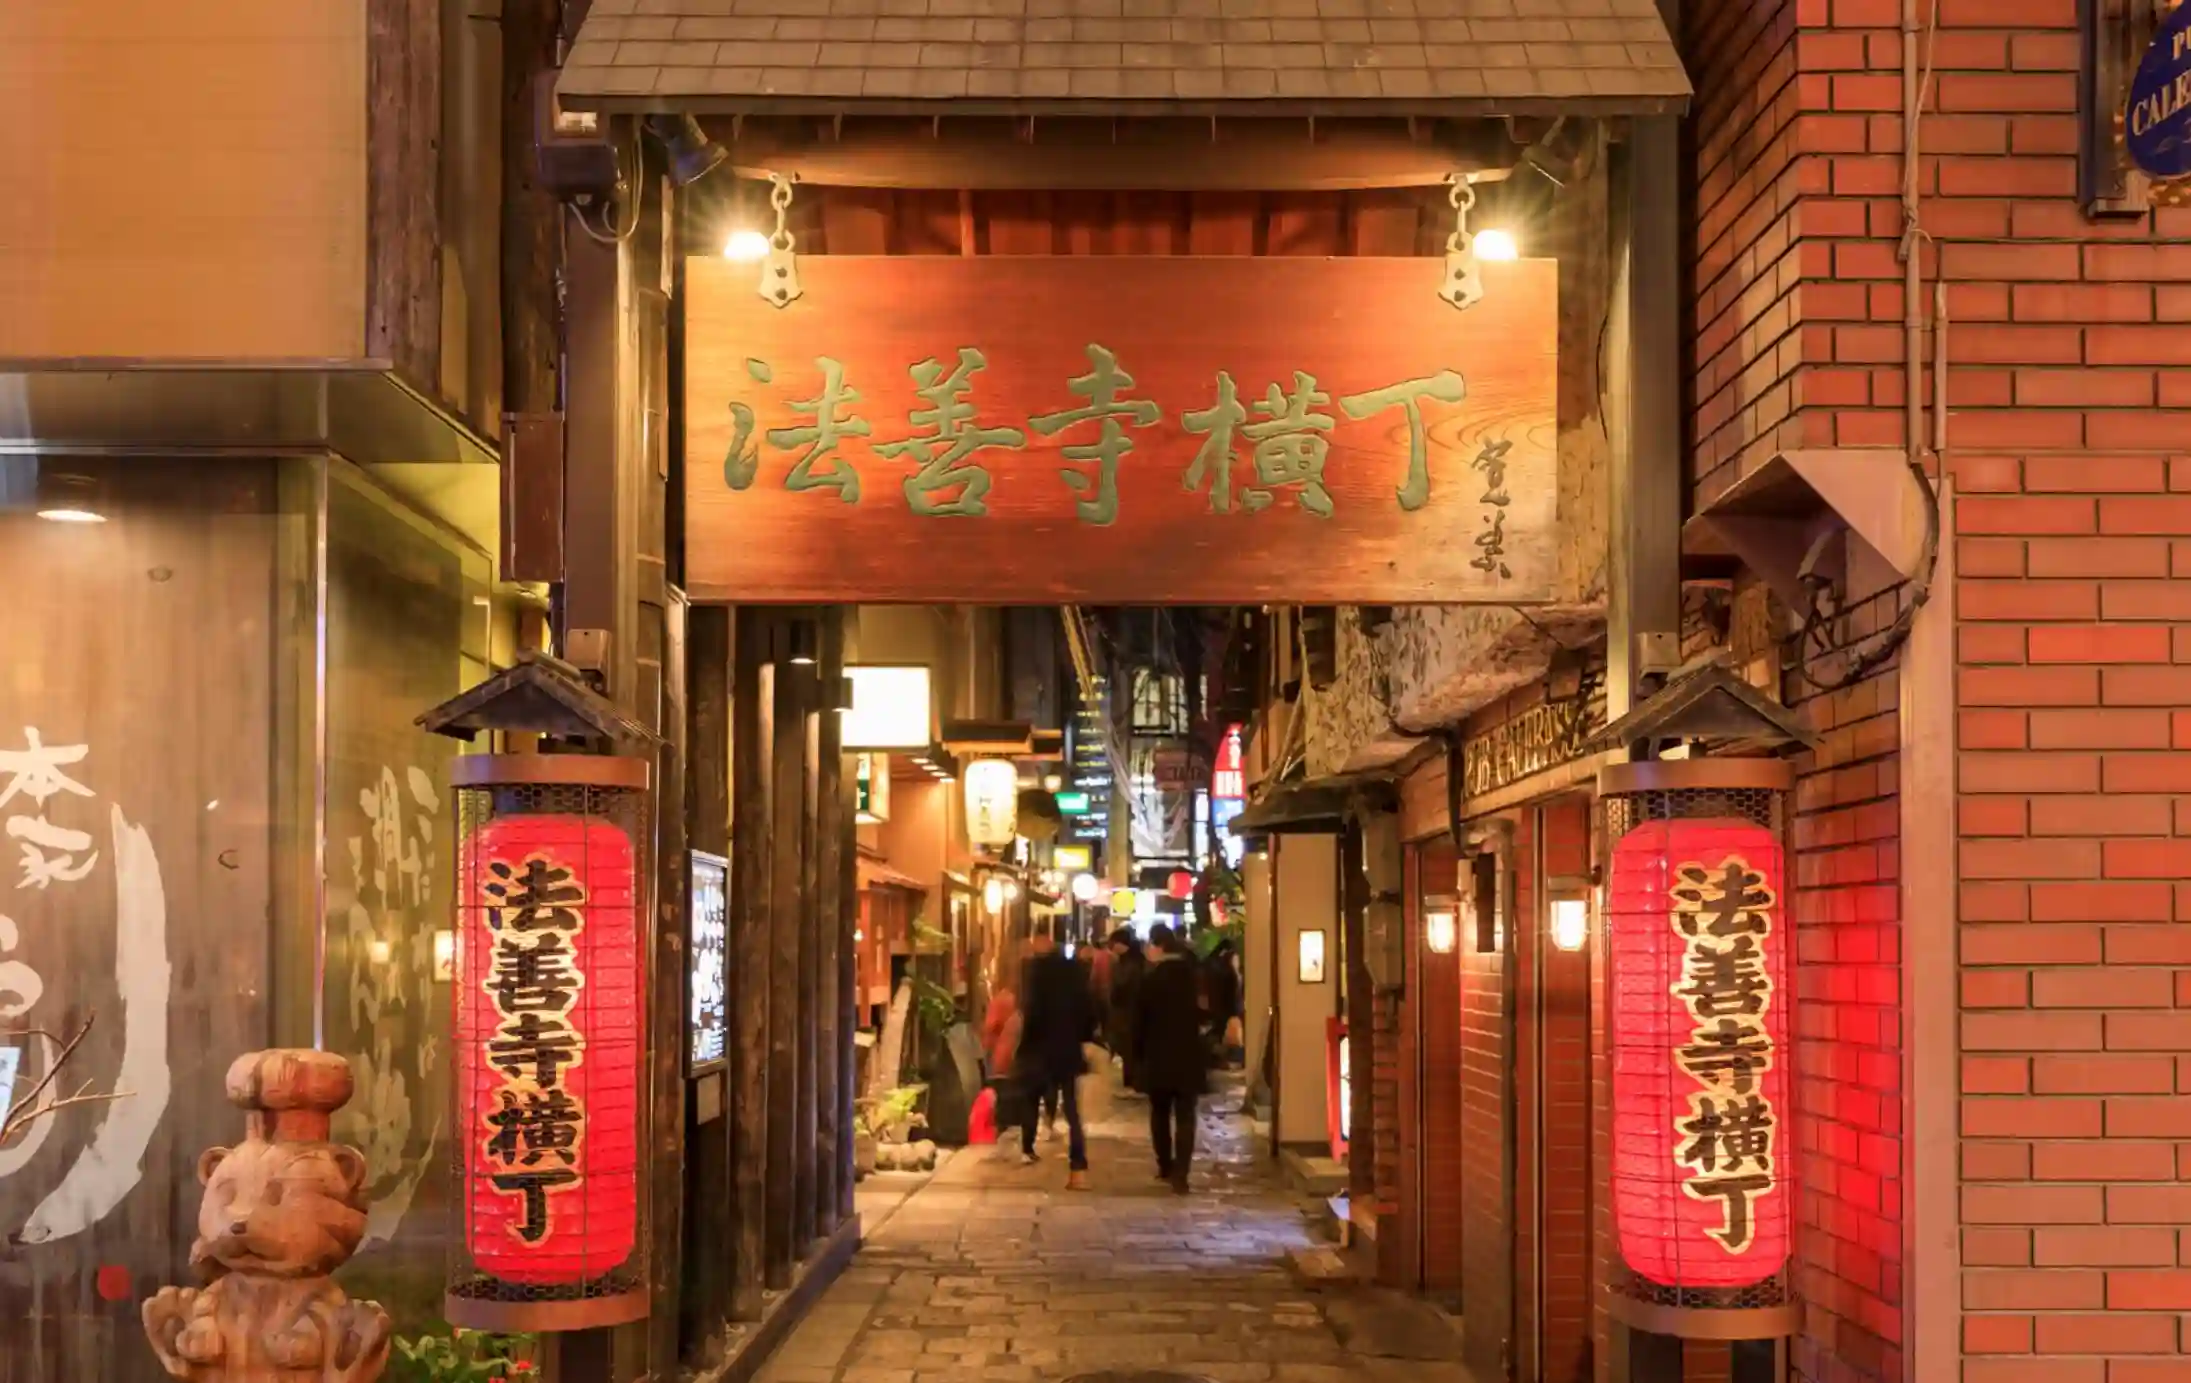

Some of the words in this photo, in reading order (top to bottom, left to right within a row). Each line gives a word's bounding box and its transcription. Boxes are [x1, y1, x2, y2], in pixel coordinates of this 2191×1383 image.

[722, 343, 1467, 527] 法善寺横丁
[485, 858, 585, 1244] 法善寺横丁
[1673, 862, 1773, 1250] 法善寺横丁
